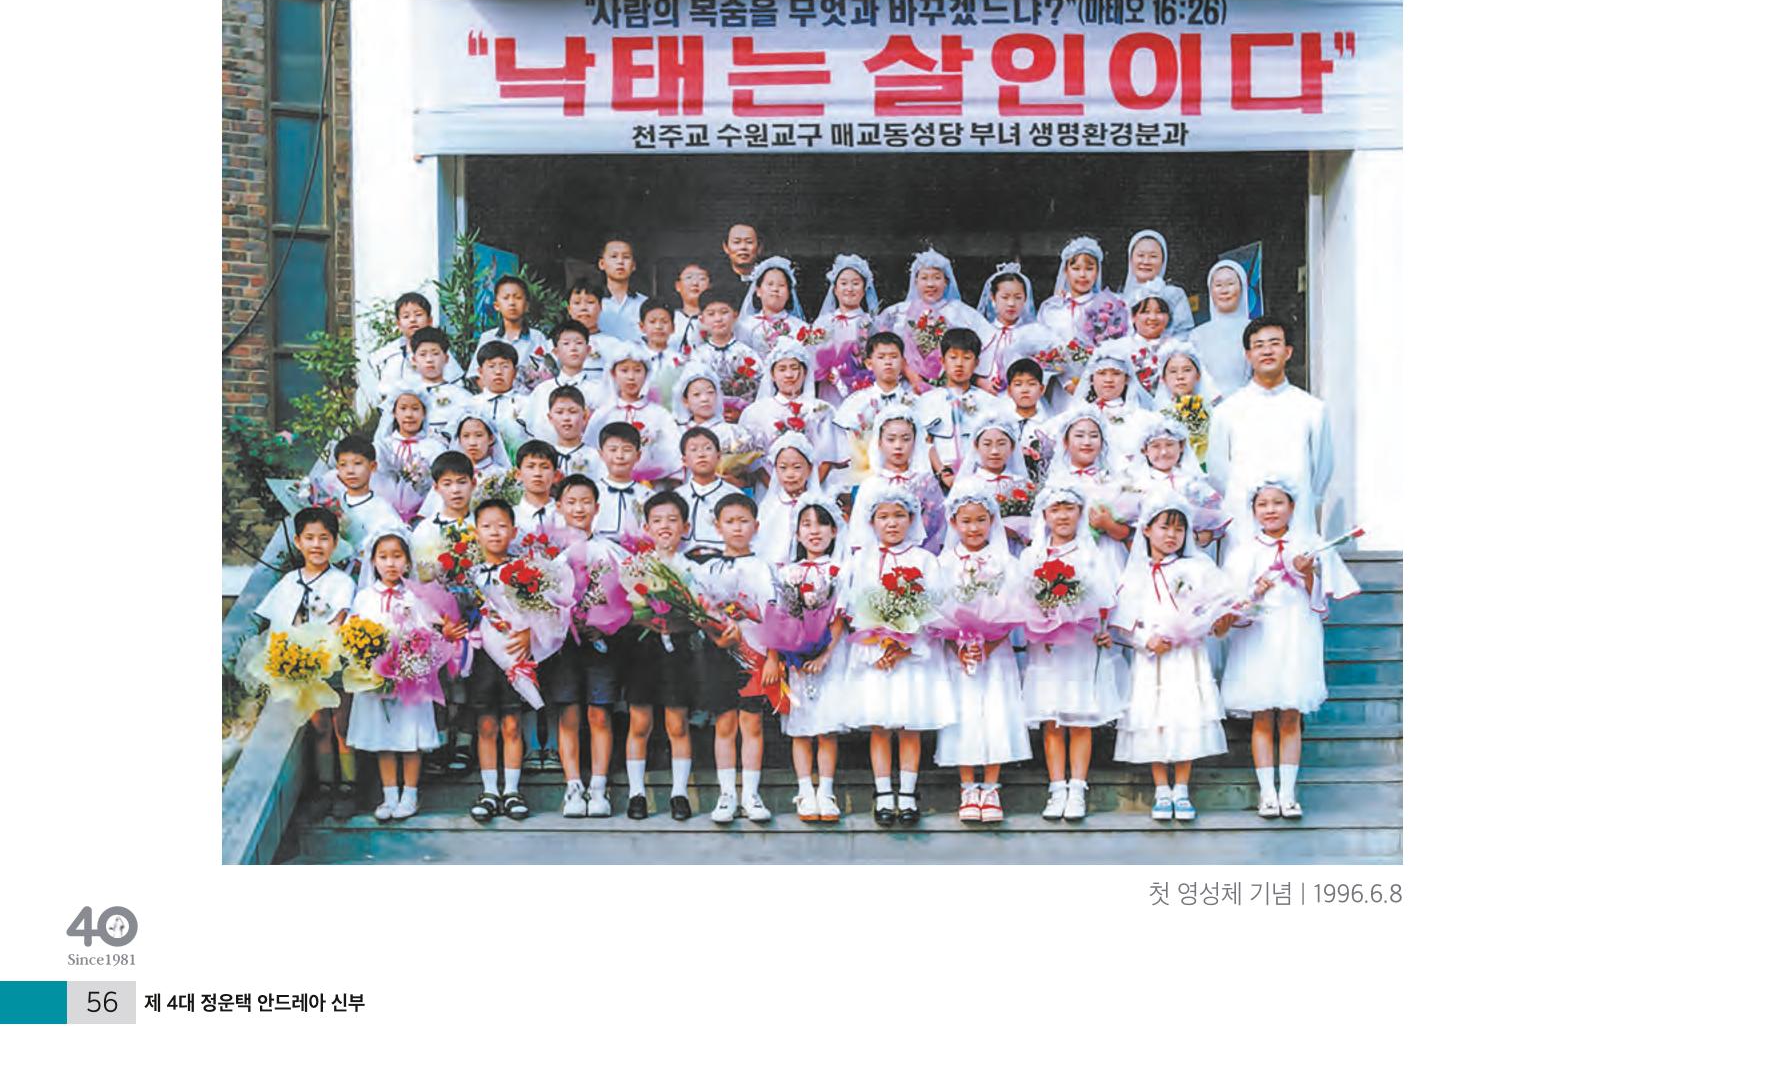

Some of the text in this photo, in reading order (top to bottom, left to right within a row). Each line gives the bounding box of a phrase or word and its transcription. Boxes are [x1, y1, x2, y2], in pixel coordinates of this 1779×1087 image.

[788, 0, 880, 27] 무엇과
[632, 122, 1189, 149] 천주교 수원교구 매교동성당 부녀 생명환경분과
